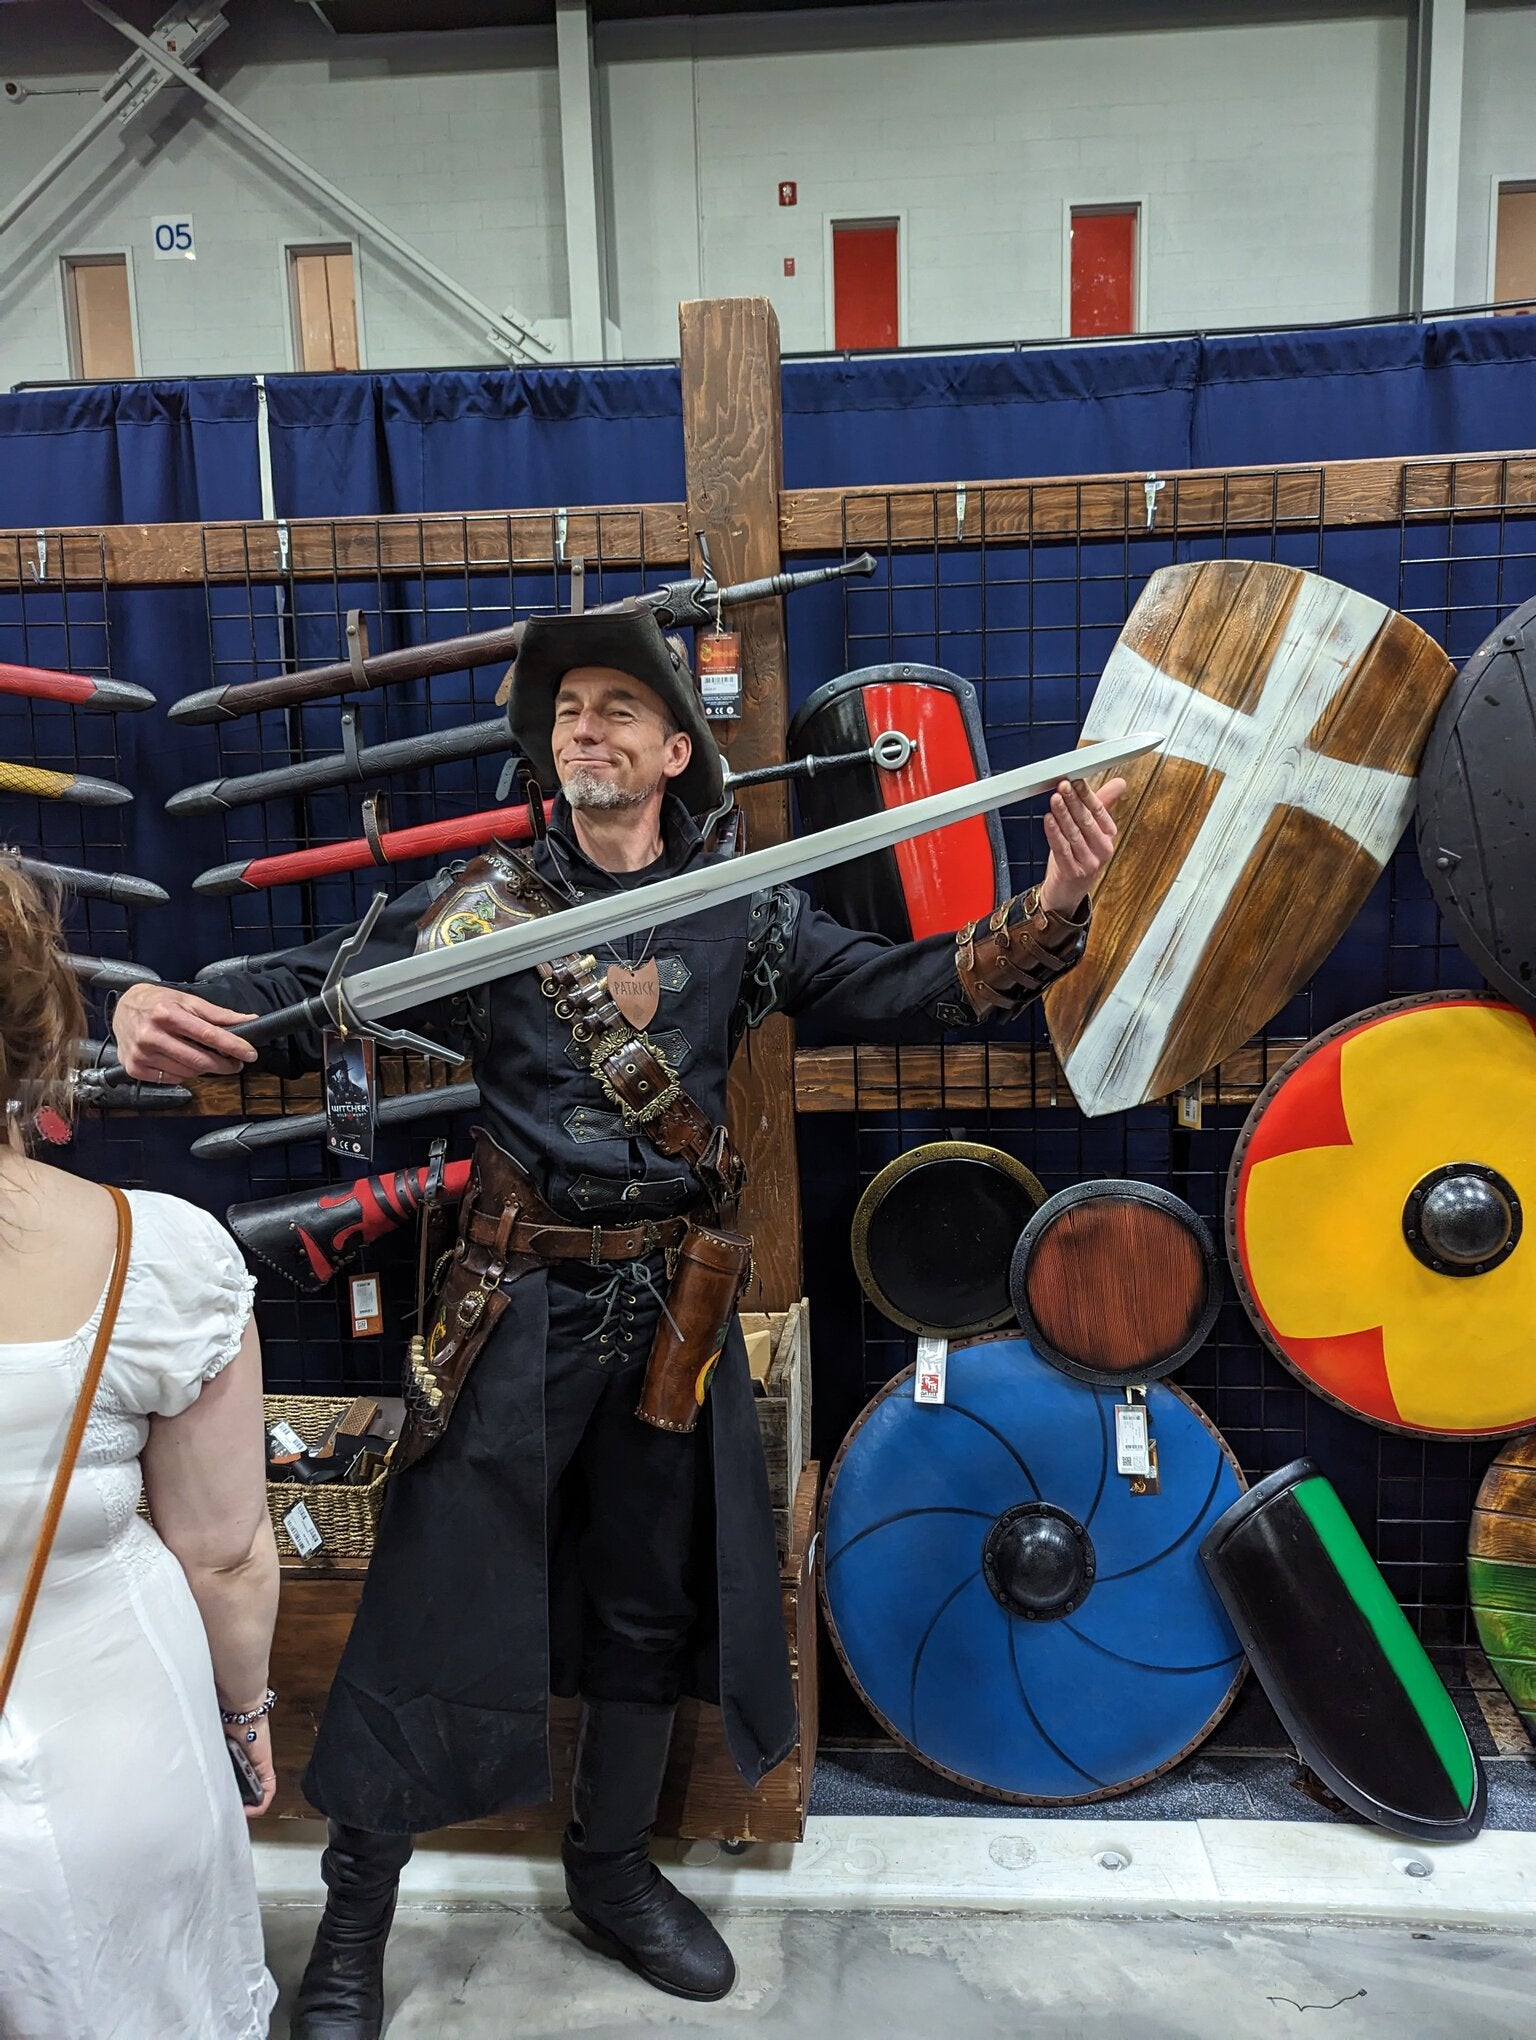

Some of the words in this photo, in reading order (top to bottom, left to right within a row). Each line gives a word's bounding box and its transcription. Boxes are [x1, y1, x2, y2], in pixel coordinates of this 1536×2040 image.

[155, 223, 193, 251] 05
[613, 981, 655, 996] PATRICK
[331, 1104, 369, 1113] WITCHER
[790, 1832, 887, 1877] 25
